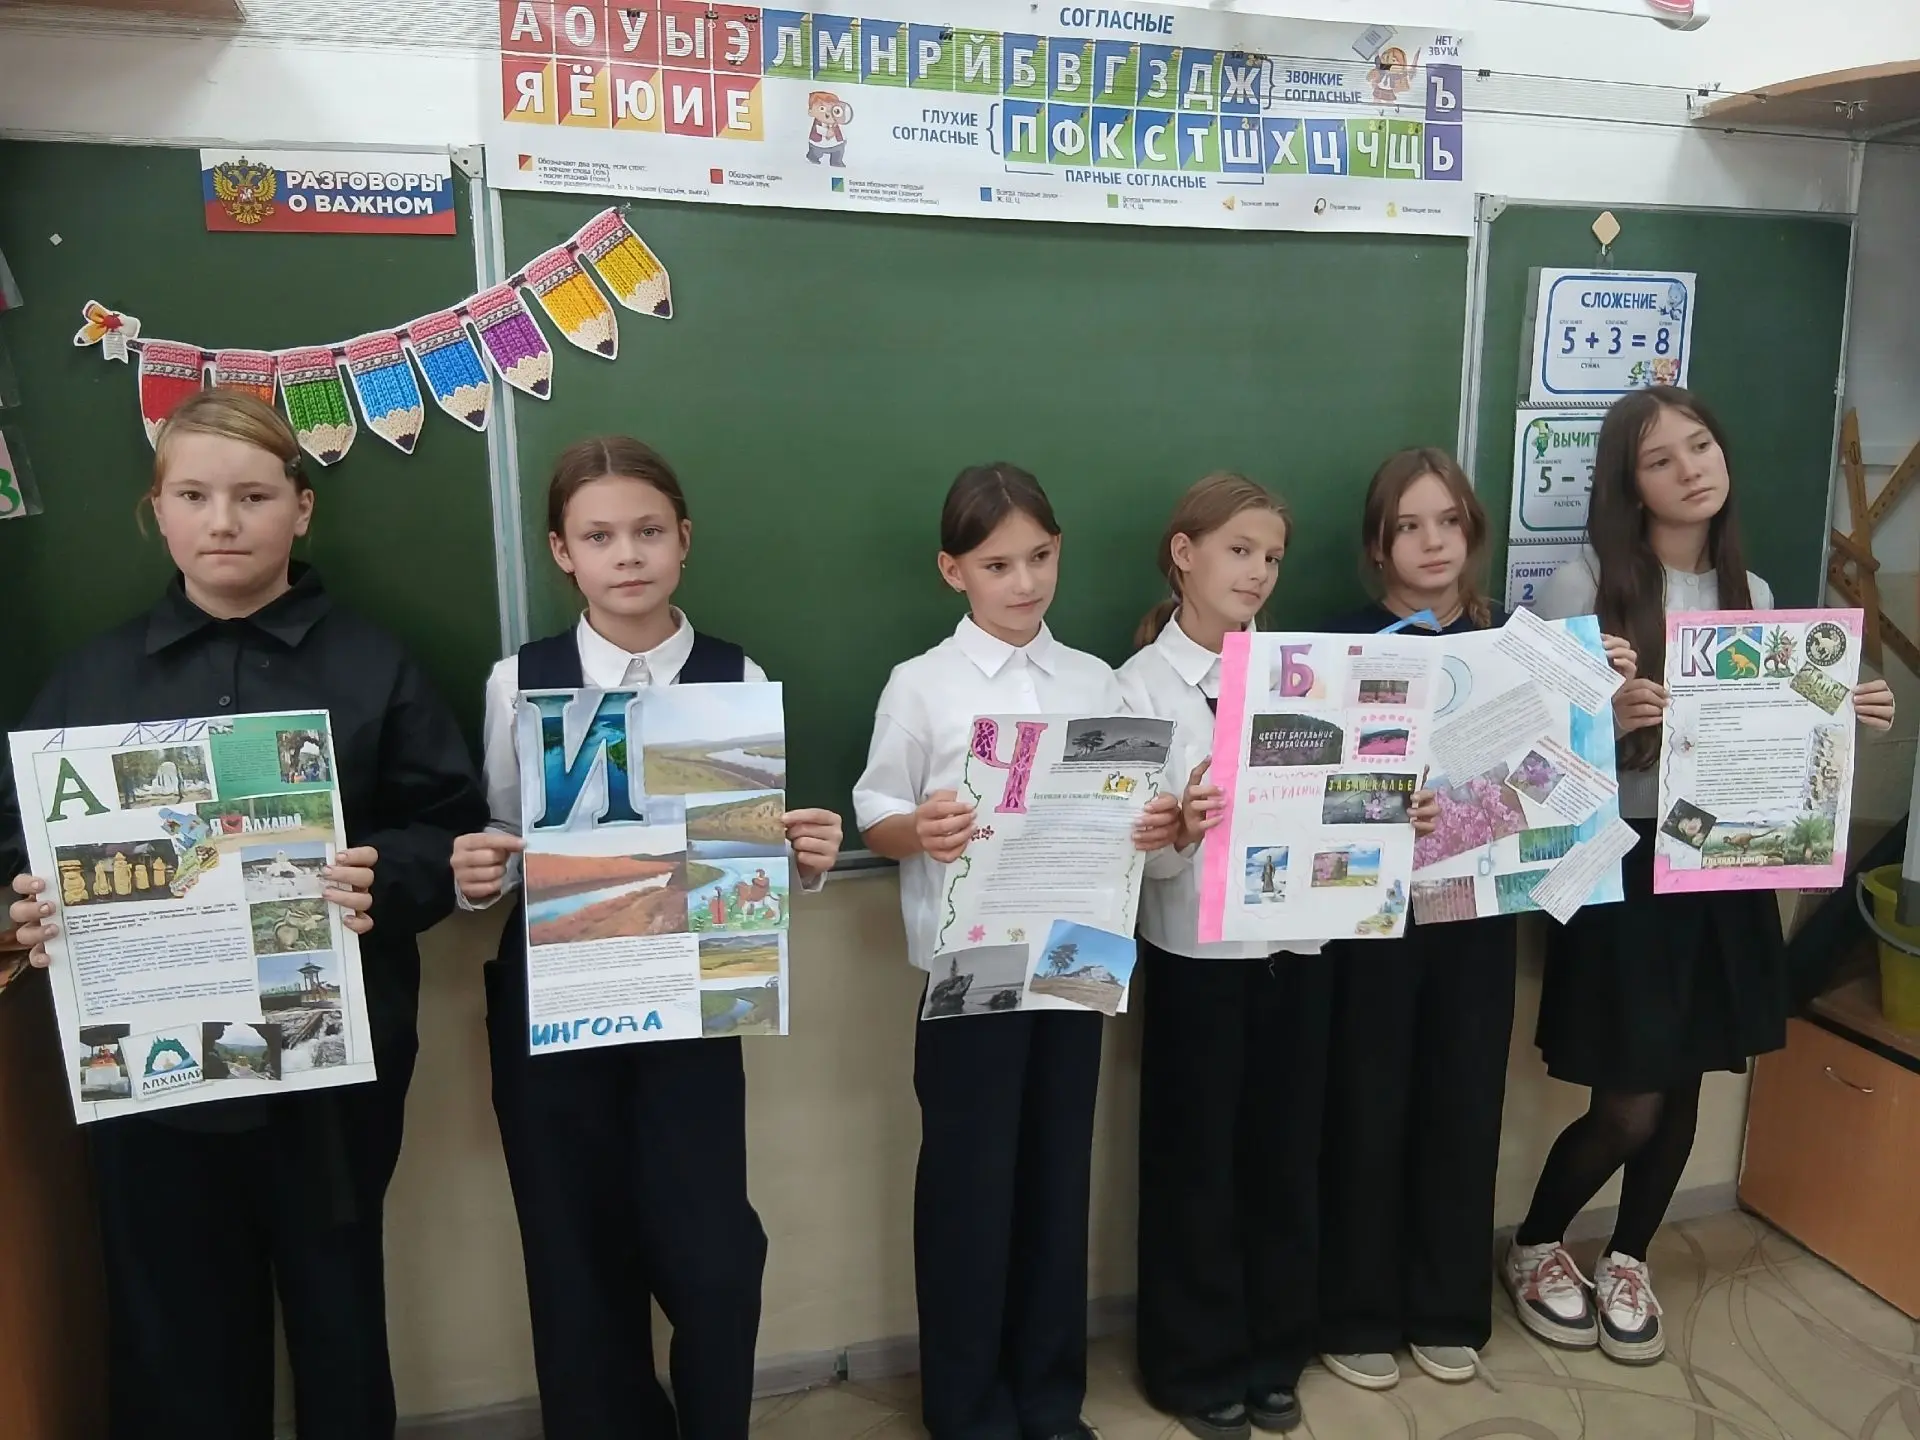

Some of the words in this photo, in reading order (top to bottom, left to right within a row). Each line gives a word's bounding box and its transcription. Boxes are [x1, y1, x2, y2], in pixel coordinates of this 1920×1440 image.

[1060, 7, 1174, 34] СОГЛАСНЫЕ
[1428, 46, 1459, 57] ЗВУКА
[1435, 36, 1453, 46] НЕТ
[510, 2, 544, 43] А
[565, 5, 596, 46] О
[617, 10, 648, 52] У
[665, 16, 705, 59] Ы
[725, 21, 750, 63] Э
[771, 27, 802, 67] Л
[818, 31, 853, 72] М
[869, 35, 896, 75] Н
[920, 39, 942, 78] Р
[964, 34, 992, 84] Й
[1013, 47, 1036, 88] Б
[1057, 52, 1081, 93] В
[1103, 55, 1127, 95] Г
[1148, 60, 1168, 98] З
[1184, 63, 1213, 112] Д
[1222, 66, 1260, 104] Ж
[1285, 70, 1344, 86] ЗВОНКИЕ
[515, 73, 544, 113] Я
[569, 65, 596, 117] Ё
[617, 79, 656, 120] Ю
[673, 84, 703, 126] И
[727, 89, 752, 131] Е
[1284, 89, 1362, 103] СОГЛАСНЫЕ
[1431, 76, 1456, 112] Ъ
[922, 109, 978, 127] ГЛУХИЕ
[892, 125, 979, 146] СОГЛАСНЫЕ
[1012, 115, 1036, 153] П
[1052, 119, 1085, 157] Ф
[1099, 120, 1126, 160] К
[1144, 123, 1168, 162] С
[1186, 127, 1211, 164] Т
[1225, 129, 1260, 164] Ш
[1272, 129, 1300, 166] Х
[1313, 131, 1342, 173] Ц
[1356, 132, 1379, 168] Ч
[1388, 133, 1422, 175] Щ
[1433, 137, 1454, 170] Ь
[286, 171, 444, 193] РАЗГОВОРЫ
[1065, 169, 1122, 185] ПАРНЫЕ
[1126, 173, 1207, 189] СОГЛАСНЫЕ
[288, 194, 307, 213] О
[315, 195, 434, 215] ВАЖНОМ
[1581, 292, 1657, 309] СЛОЖЕНИЕ
[1562, 326, 1576, 354] 5
[1608, 326, 1622, 354] 3
[1655, 328, 1670, 354] 8
[1538, 466, 1552, 493] 5
[1516, 568, 1556, 578] КОМПО
[1522, 584, 1534, 600] 2
[1682, 628, 1716, 677] К
[1280, 644, 1314, 698] Б
[526, 691, 644, 828] И
[972, 718, 1048, 814] Ч
[46, 758, 110, 822] А
[1328, 776, 1413, 791] ЗАБАЙКАЛЬЕ
[210, 818, 224, 836] Я
[532, 1010, 663, 1046] ИНГОДА
